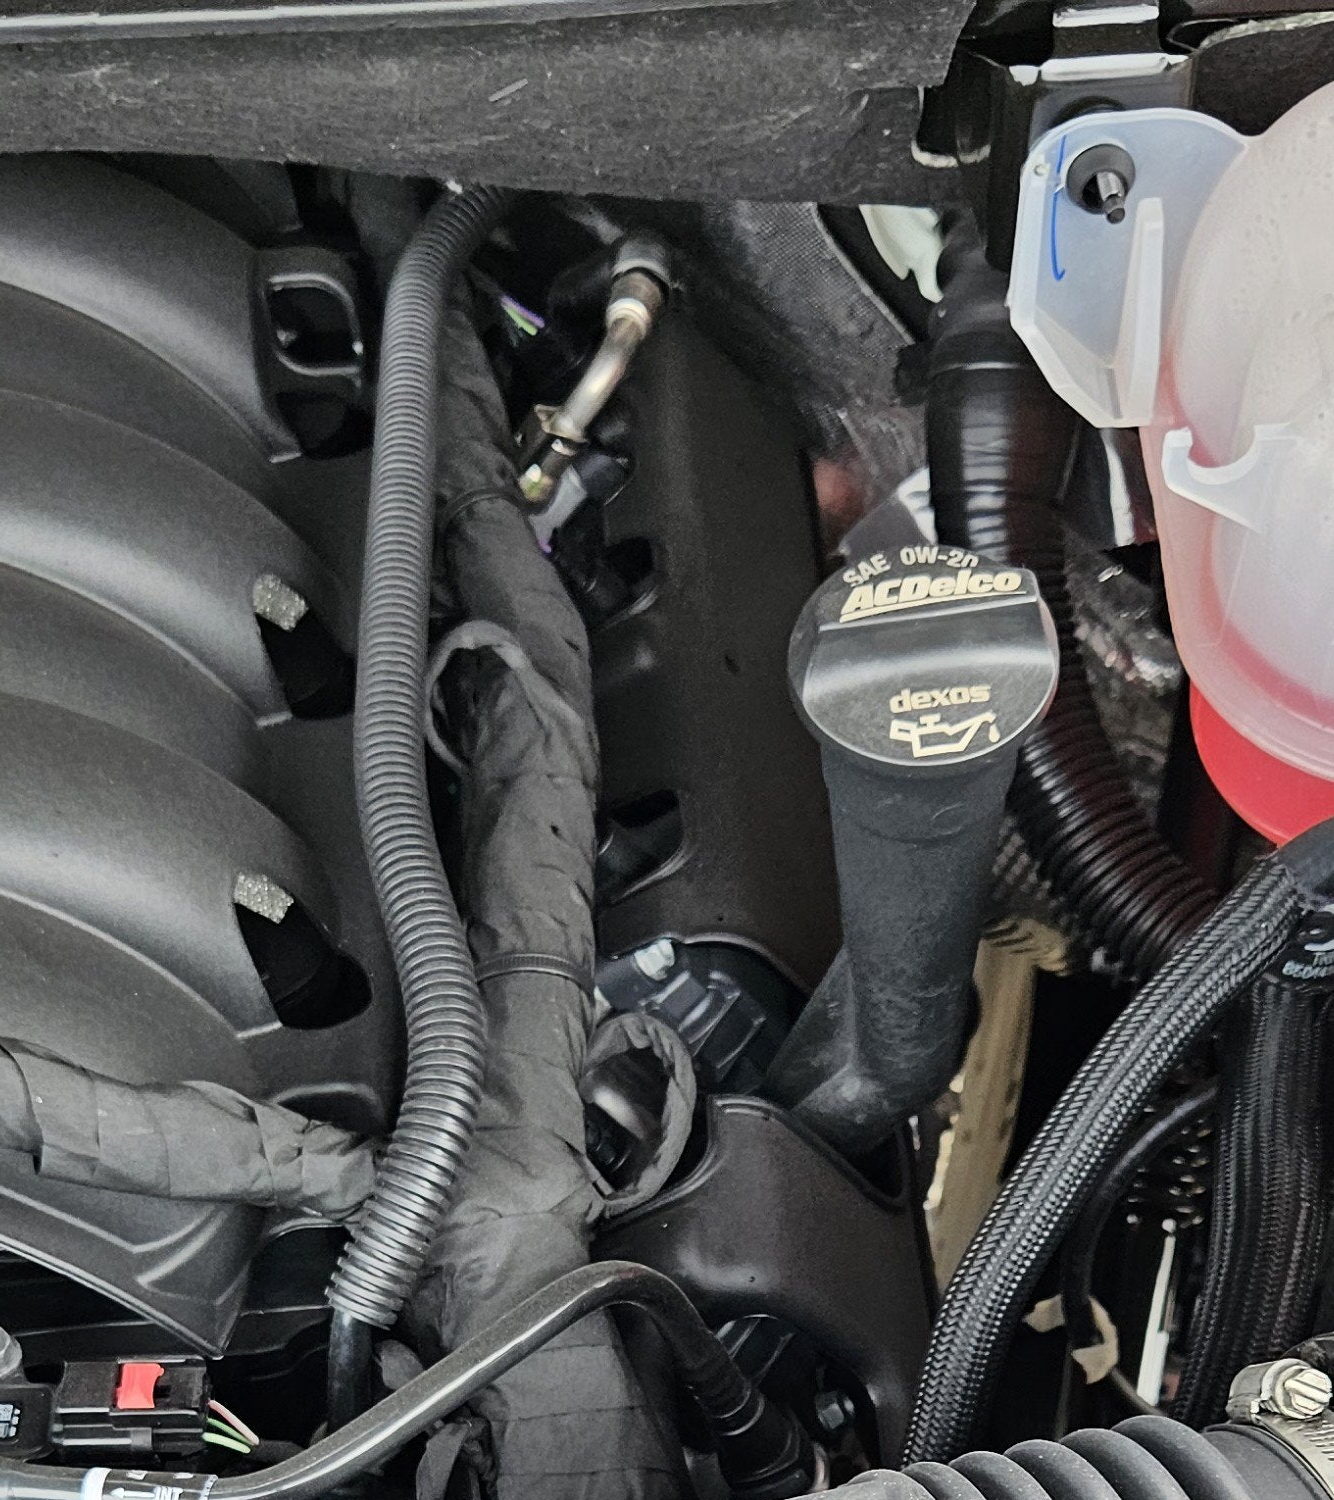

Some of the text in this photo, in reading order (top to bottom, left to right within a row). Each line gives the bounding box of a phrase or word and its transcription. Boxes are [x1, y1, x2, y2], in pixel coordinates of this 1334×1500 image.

[842, 553, 891, 588] SAE
[839, 569, 1023, 615] ACDelco
[889, 683, 992, 714] dexos
